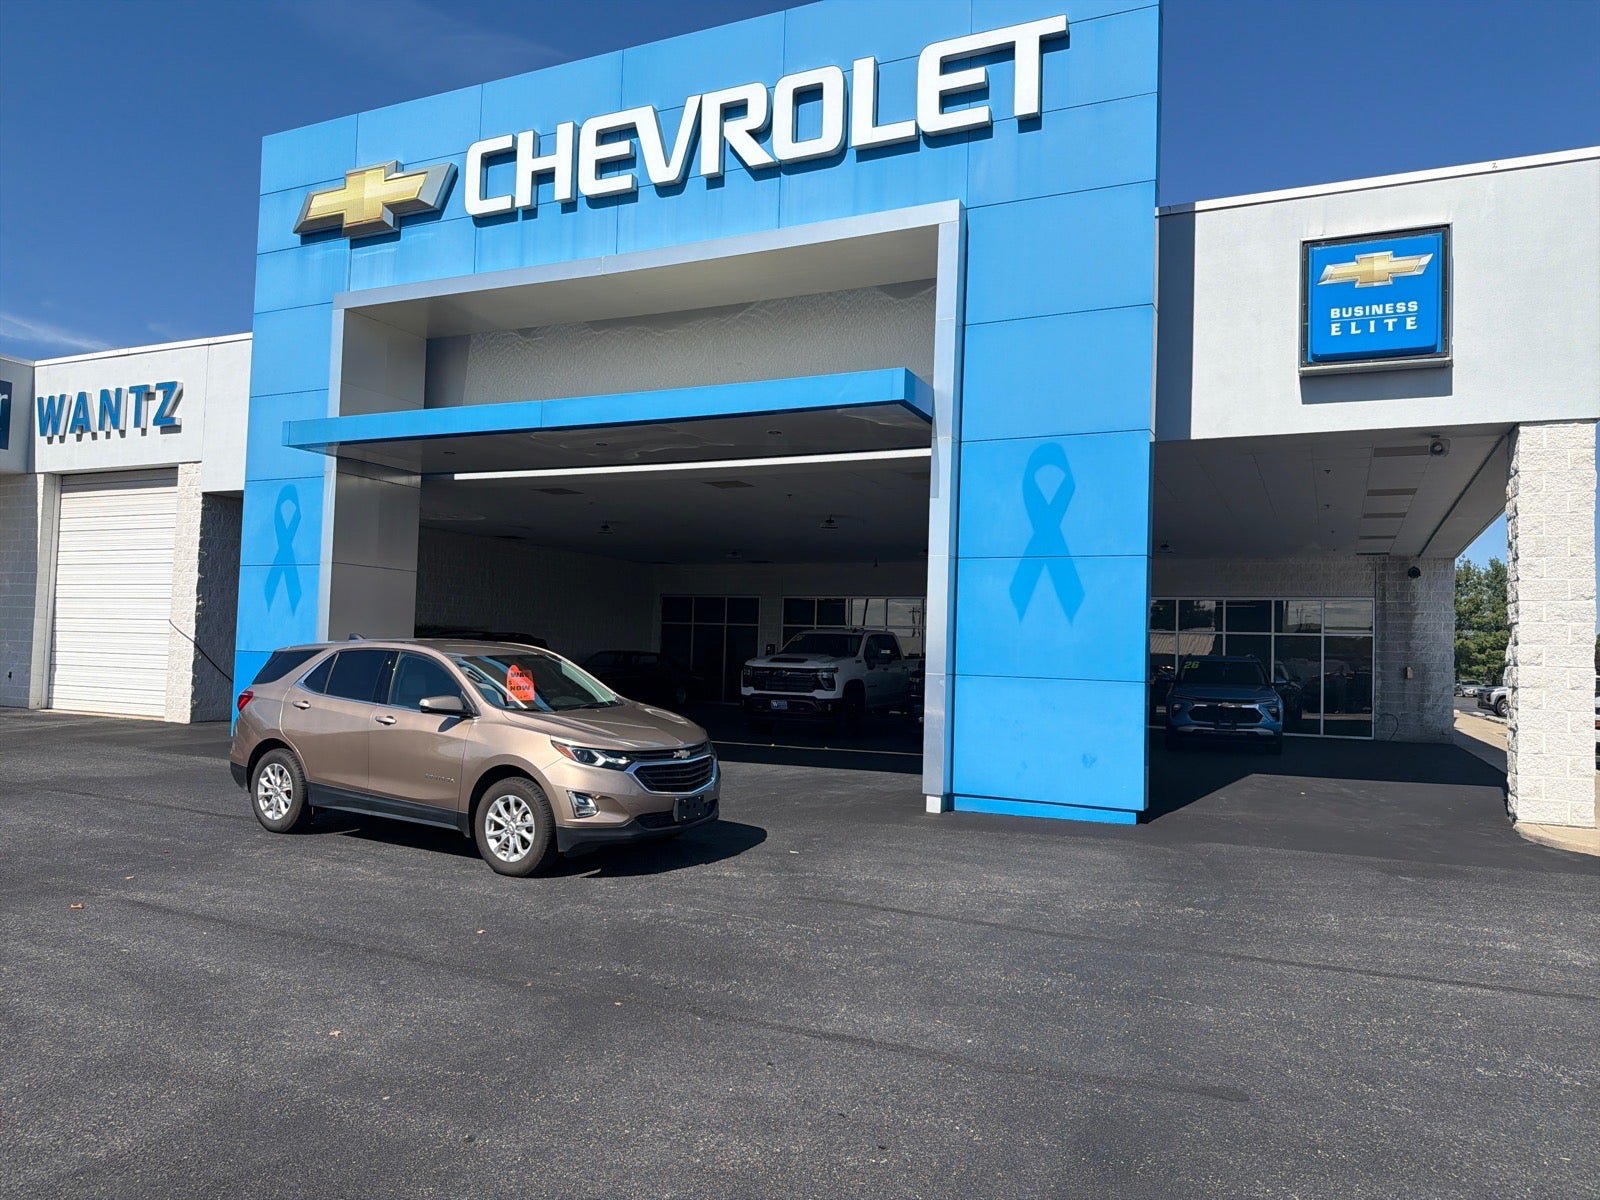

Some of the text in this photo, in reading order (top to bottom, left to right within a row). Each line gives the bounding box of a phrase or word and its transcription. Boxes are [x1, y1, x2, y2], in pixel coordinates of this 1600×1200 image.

[465, 15, 1068, 217] CHEVROLET
[1330, 301, 1418, 319] BUSINESS
[1330, 317, 1418, 336] ELITE
[37, 381, 182, 438] WANTZ
